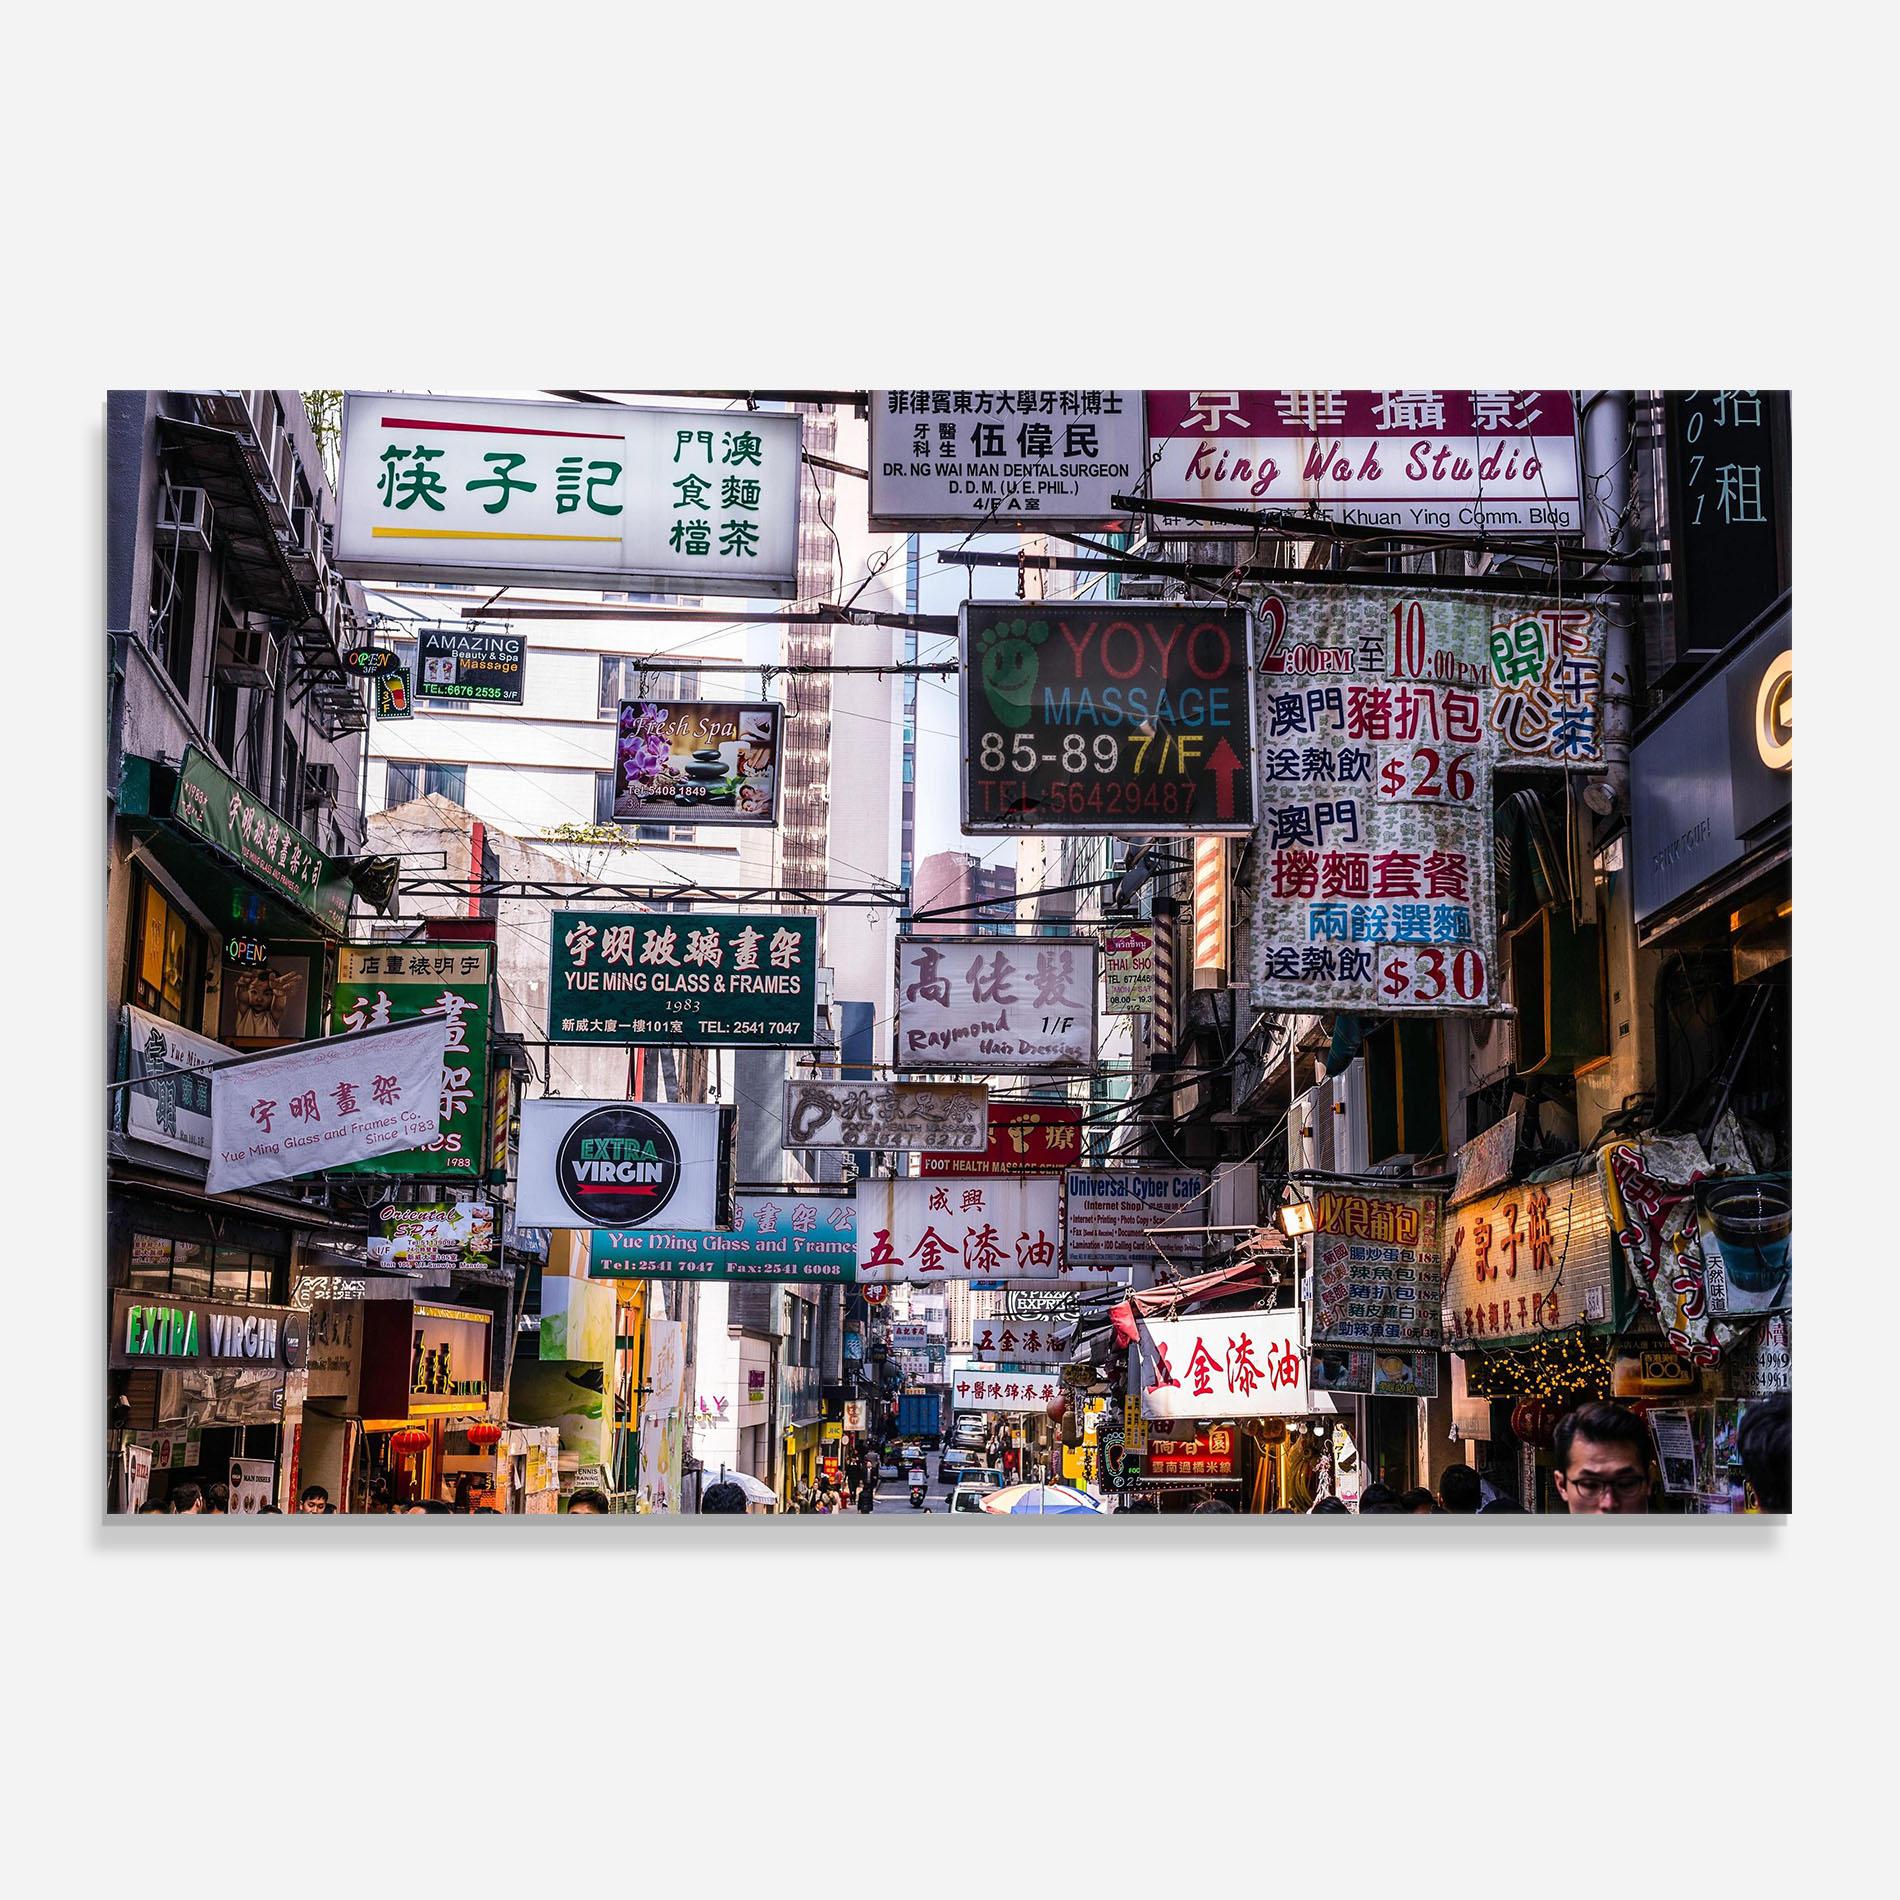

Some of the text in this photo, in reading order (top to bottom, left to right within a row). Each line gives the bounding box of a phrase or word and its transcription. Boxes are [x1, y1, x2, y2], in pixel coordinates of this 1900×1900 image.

[970, 422, 1099, 458] 伍偉民
[377, 445, 623, 515] 筷子記
[883, 463, 907, 477] DR.
[911, 463, 931, 477] NG
[935, 463, 962, 477] WAI
[967, 463, 999, 477] MAN
[1185, 440, 1543, 496] King Wah Studio
[1344, 508, 1401, 525] Khuan
[1410, 508, 1451, 528] Ying
[1457, 508, 1523, 525] Comm.
[1530, 507, 1570, 527] Bldg
[426, 634, 519, 653] AMAZING
[1259, 596, 1355, 675] 2:00PM
[1390, 600, 1487, 684] 10:00PM
[349, 652, 391, 667] OPEN
[452, 650, 519, 663] Beauty & Spa
[1060, 622, 1231, 680] YOYO
[1358, 636, 1385, 672] 至
[460, 659, 518, 673] Massage
[475, 687, 501, 699] 2535
[504, 691, 518, 700] 3/F
[1044, 687, 1231, 728] MASSAGE
[630, 715, 734, 745] Fresh Spa
[980, 732, 1204, 775] 85-89 7/F
[1266, 747, 1371, 783] 送熱飲
[1381, 747, 1475, 801] $26
[649, 785, 706, 797] 5408 1849
[1268, 800, 1359, 850] 澳門
[1271, 850, 1469, 902] 撈麵套餐
[229, 940, 263, 962] OPEN
[565, 921, 801, 971] 宇明玻璃畫架
[1107, 959, 1128, 971] THAI
[1265, 947, 1371, 982] 送熱飲
[1383, 948, 1485, 1000] $30
[564, 971, 801, 994] YUE MING GLASS & FRAMES
[665, 998, 701, 1013] 1983
[698, 1021, 730, 1034] TEL:
[733, 1021, 764, 1034] 2541
[768, 1022, 801, 1035] 7047
[907, 1009, 1010, 1052] Raymond
[1042, 1016, 1074, 1035] 1/F
[250, 1075, 403, 1134] 宇明畫架
[221, 1110, 421, 1163] Yue Ming Glass and Frames Co.
[366, 1129, 398, 1146] Since
[404, 1119, 435, 1137] 1983
[447, 1158, 471, 1167] 1983
[580, 1137, 658, 1161] EXTRA
[571, 1161, 663, 1183] VIRGIN
[925, 1159, 951, 1171] FOOT
[952, 1160, 989, 1173] HEALTH
[1070, 1175, 1201, 1199] Universal Cyber Café
[379, 1205, 457, 1222] Oriental
[929, 1186, 986, 1216] 成興
[1120, 1201, 1145, 1212] Shop)
[394, 1223, 439, 1237] SPA
[608, 1232, 643, 1249] Yue
[649, 1234, 697, 1252] Ming
[703, 1236, 750, 1252] Glass
[755, 1237, 787, 1252] and
[861, 1223, 1055, 1273] 五金漆油
[678, 1260, 841, 1275] 7047 6008
[1708, 1256, 1726, 1312] 天然味道
[125, 1305, 199, 1358] EXTRA
[208, 1313, 278, 1359] VIRGIN
